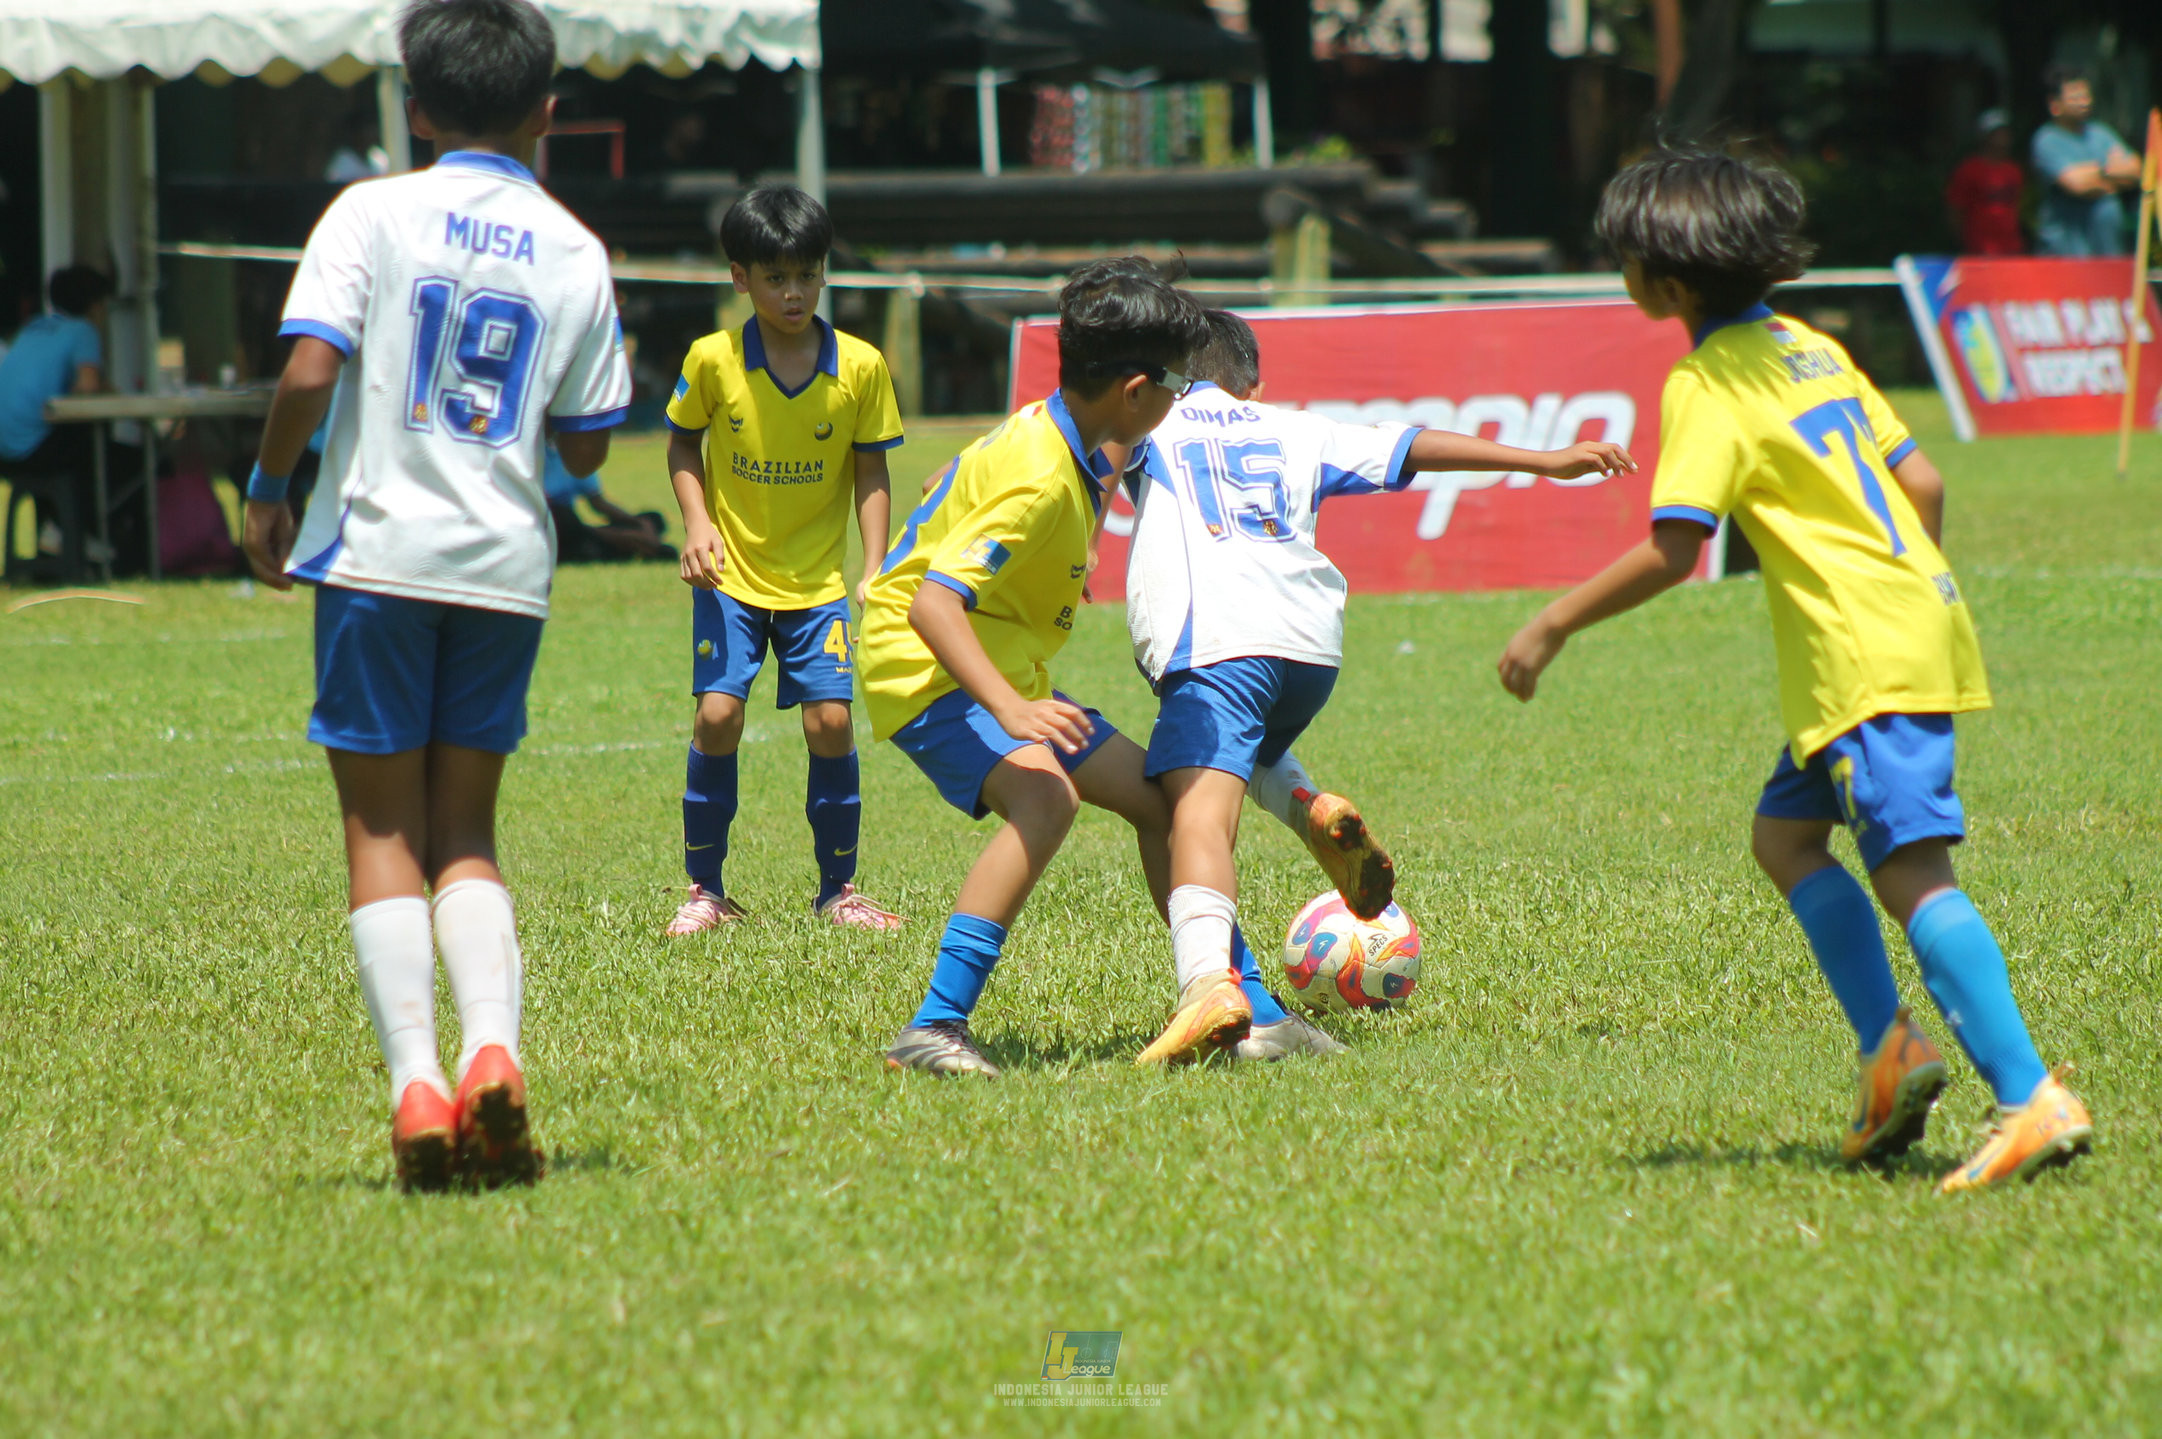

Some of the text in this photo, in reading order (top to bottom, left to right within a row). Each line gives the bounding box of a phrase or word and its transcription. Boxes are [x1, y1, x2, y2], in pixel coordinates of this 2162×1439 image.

[444, 212, 534, 265] MUSA
[404, 275, 547, 449] 19
[1180, 405, 1261, 427] DIMAS
[733, 451, 823, 474] BRAZILIAN
[731, 465, 824, 485] SOCCER SCHOOLS
[1172, 437, 1297, 543] 15
[1368, 935, 1389, 957] SPECS
